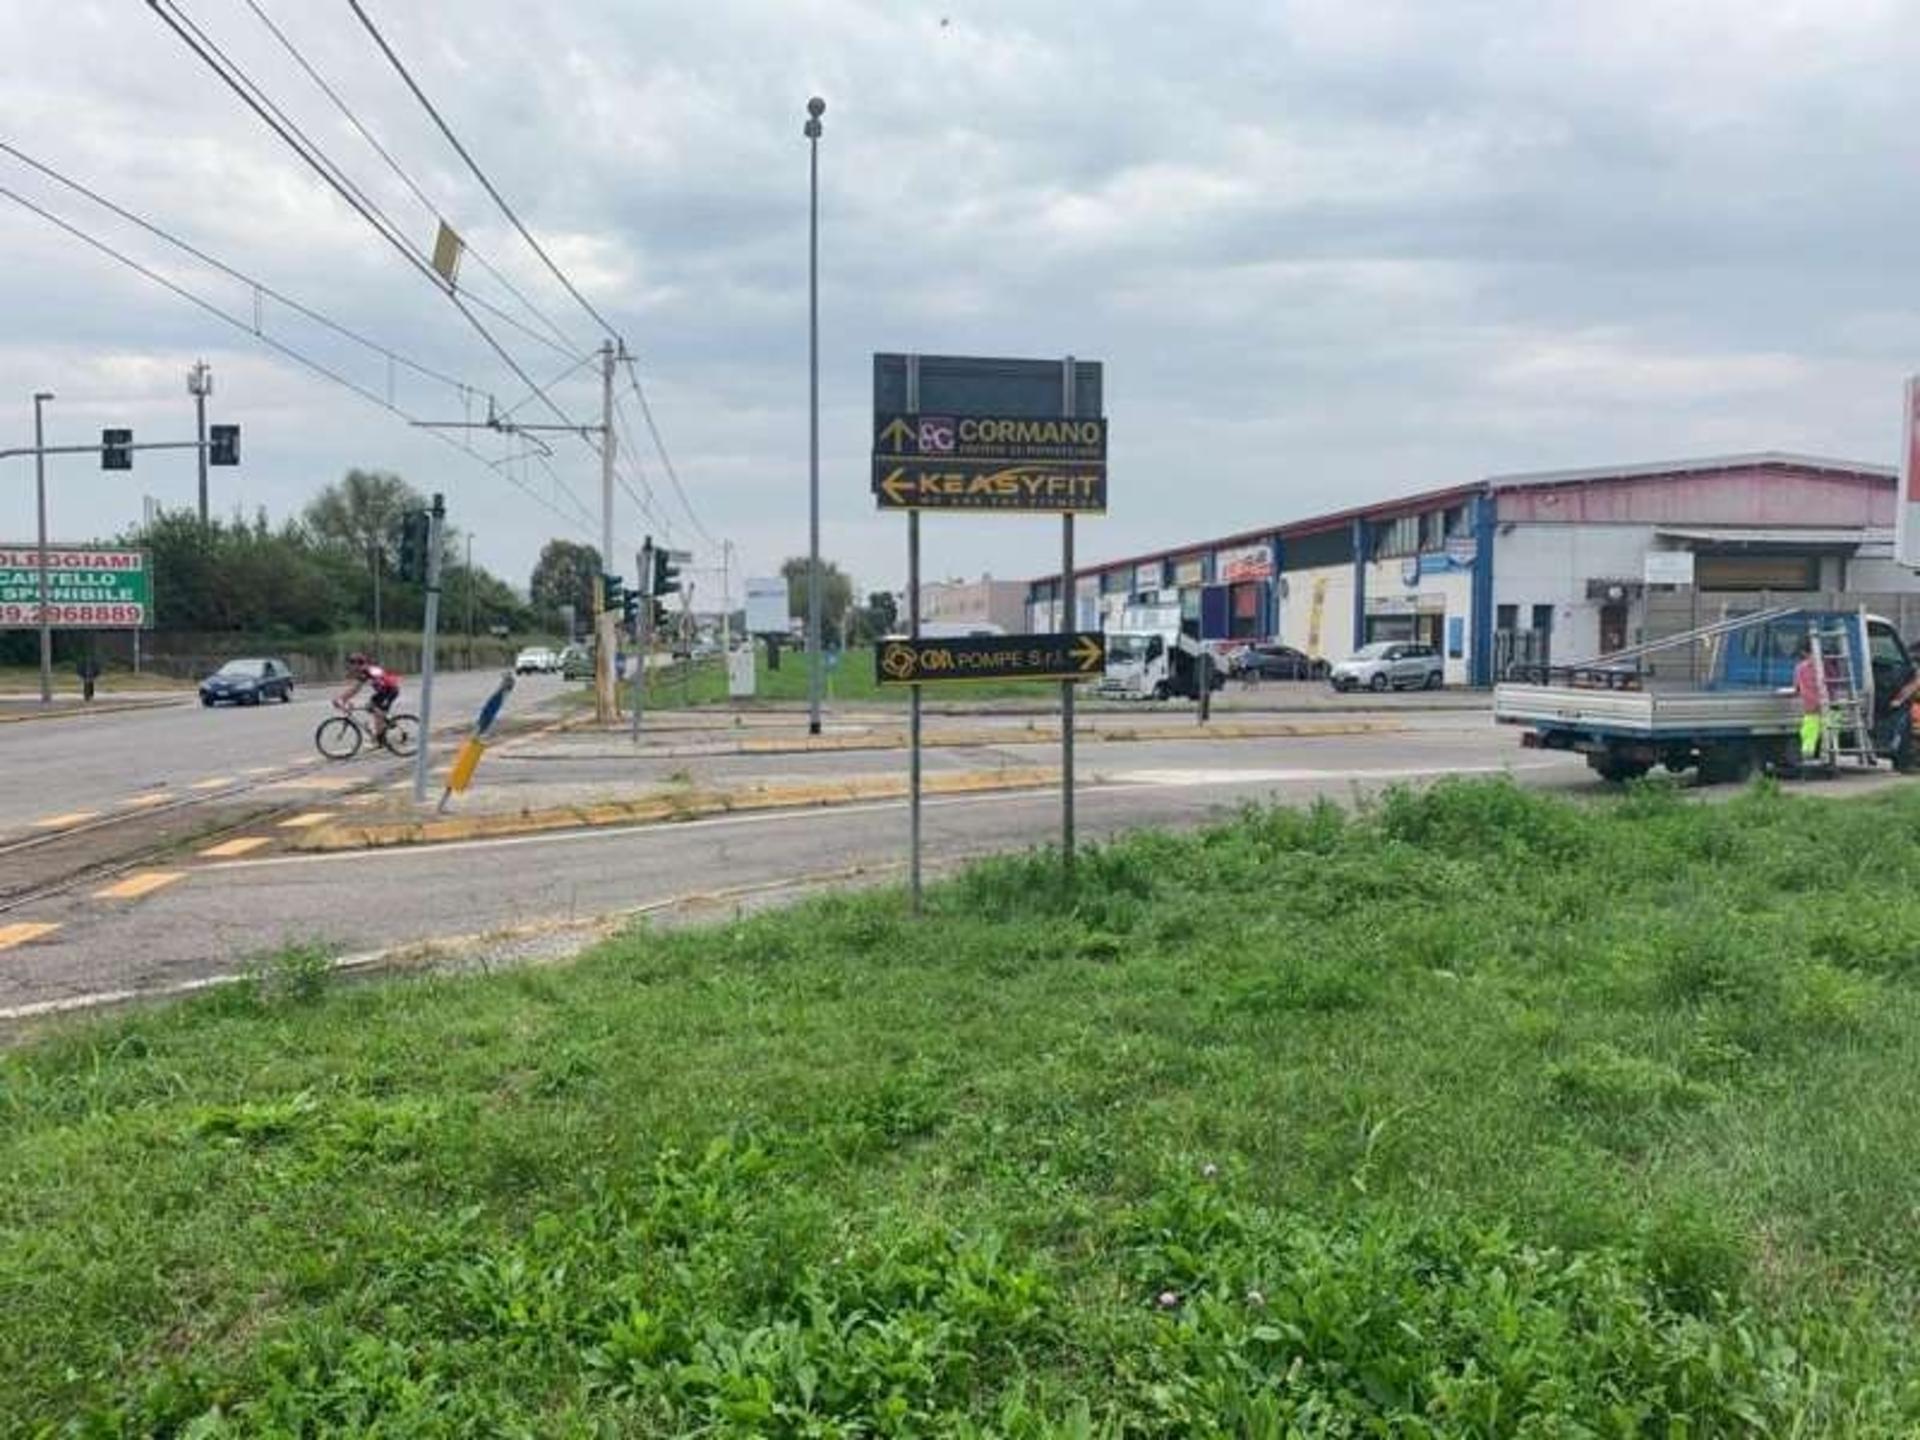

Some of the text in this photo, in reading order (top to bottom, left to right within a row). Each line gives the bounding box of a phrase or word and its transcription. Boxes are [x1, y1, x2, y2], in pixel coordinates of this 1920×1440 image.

[959, 419, 1101, 444] CORMANO
[919, 471, 1099, 496] KEASYFIT
[0, 572, 117, 587] CARTELLO
[958, 652, 1025, 669] POMPE
